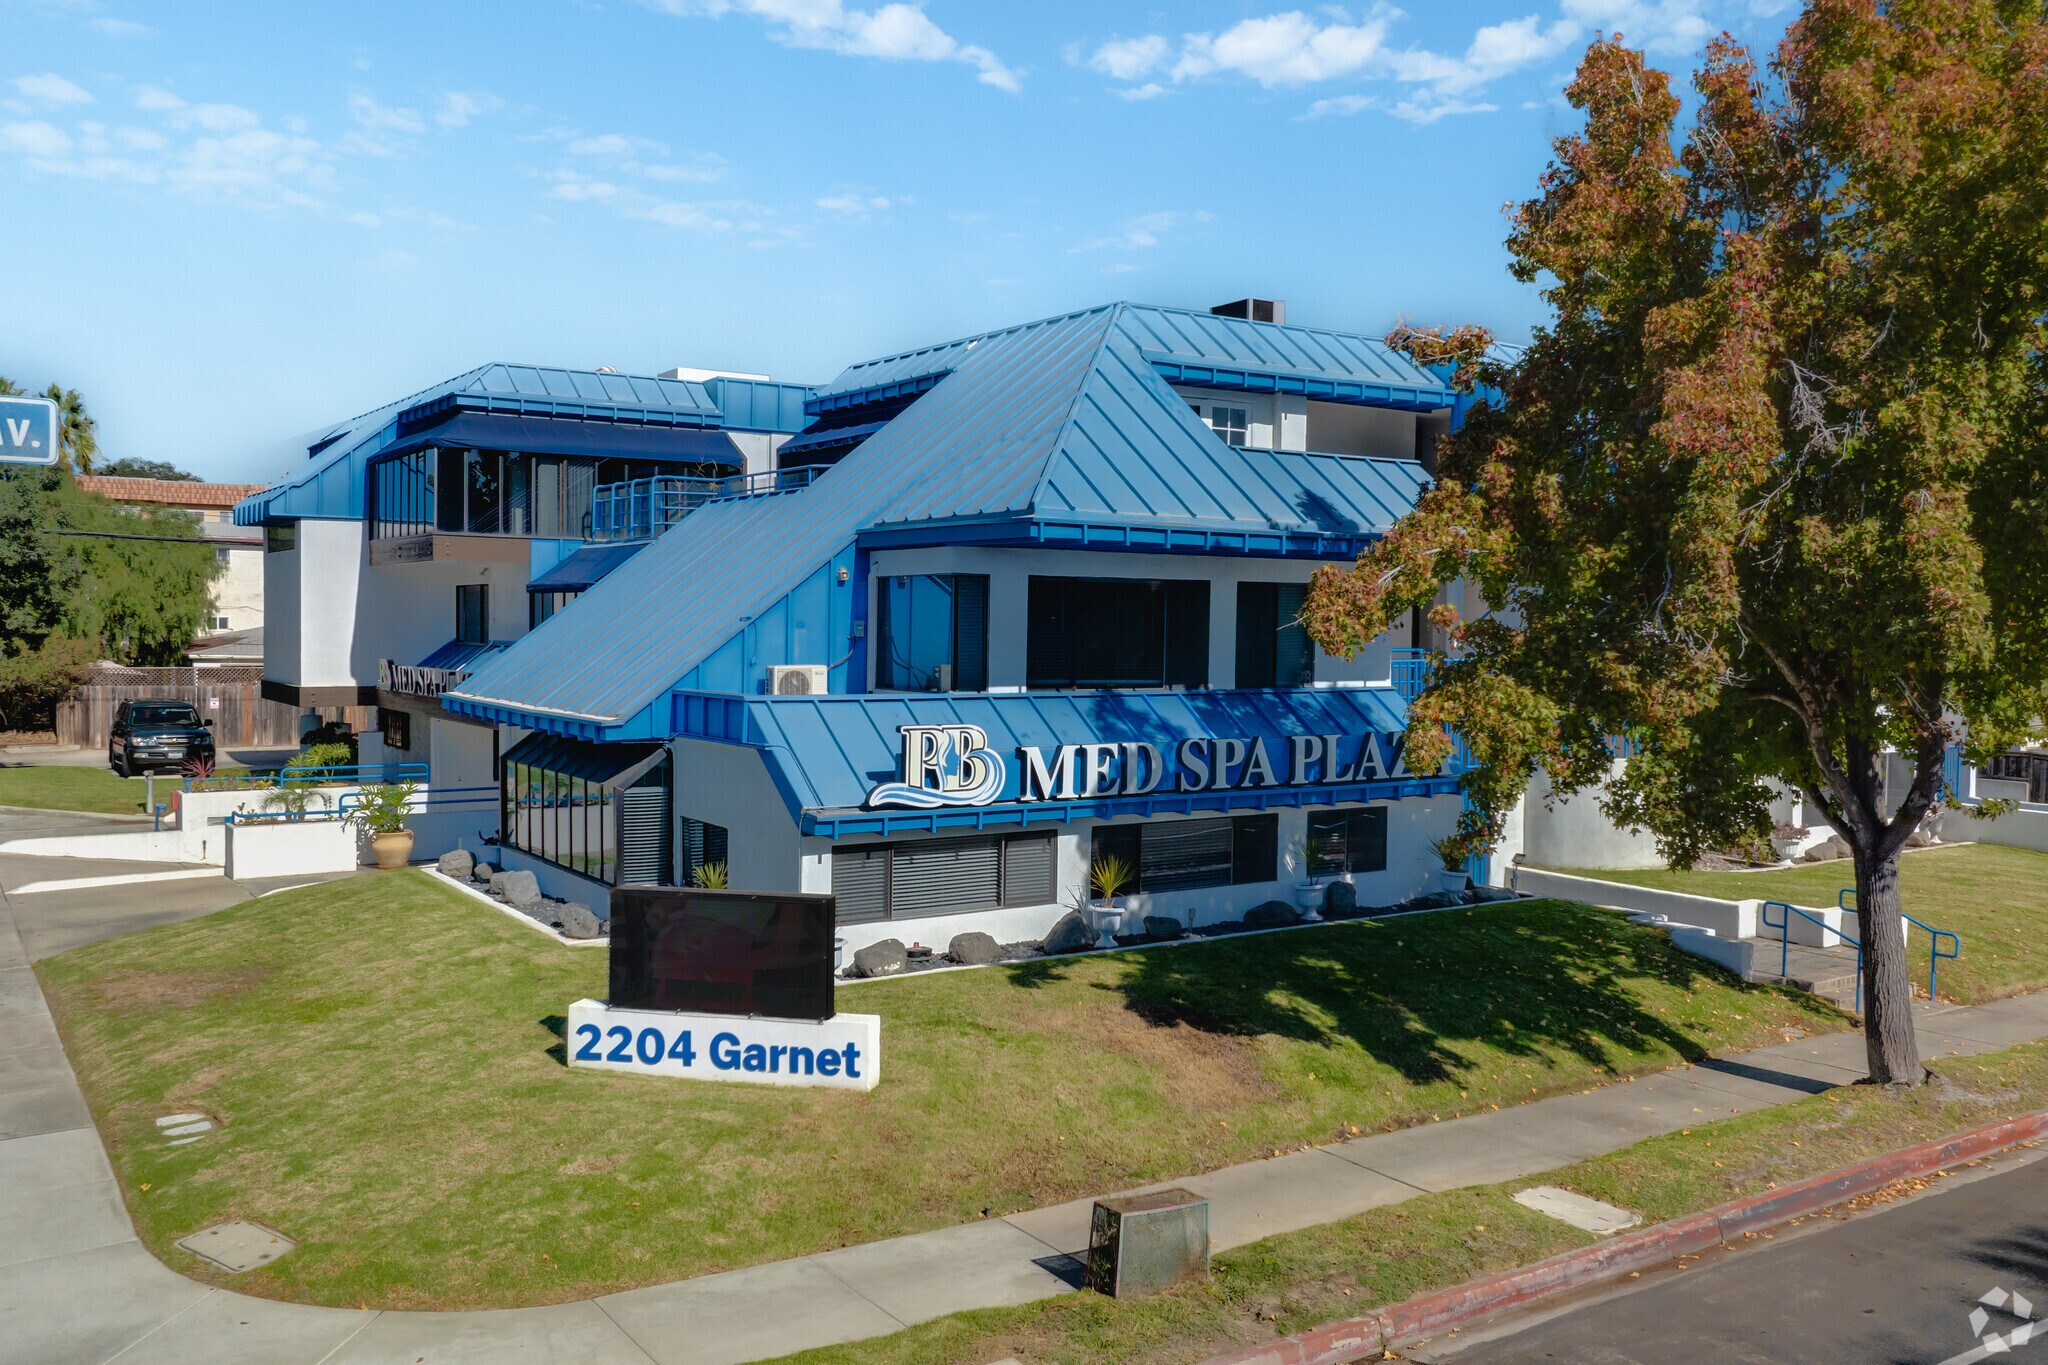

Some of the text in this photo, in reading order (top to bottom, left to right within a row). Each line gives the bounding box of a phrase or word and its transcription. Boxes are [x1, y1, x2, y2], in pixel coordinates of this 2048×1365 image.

[0, 418, 40, 447] V.
[392, 665, 416, 693] MED
[417, 668, 437, 698] SPA
[1016, 741, 1163, 801] MED
[1178, 736, 1278, 792] SPA
[1289, 730, 1452, 785] PLAZ
[575, 1023, 861, 1078] 2204 Garnet
